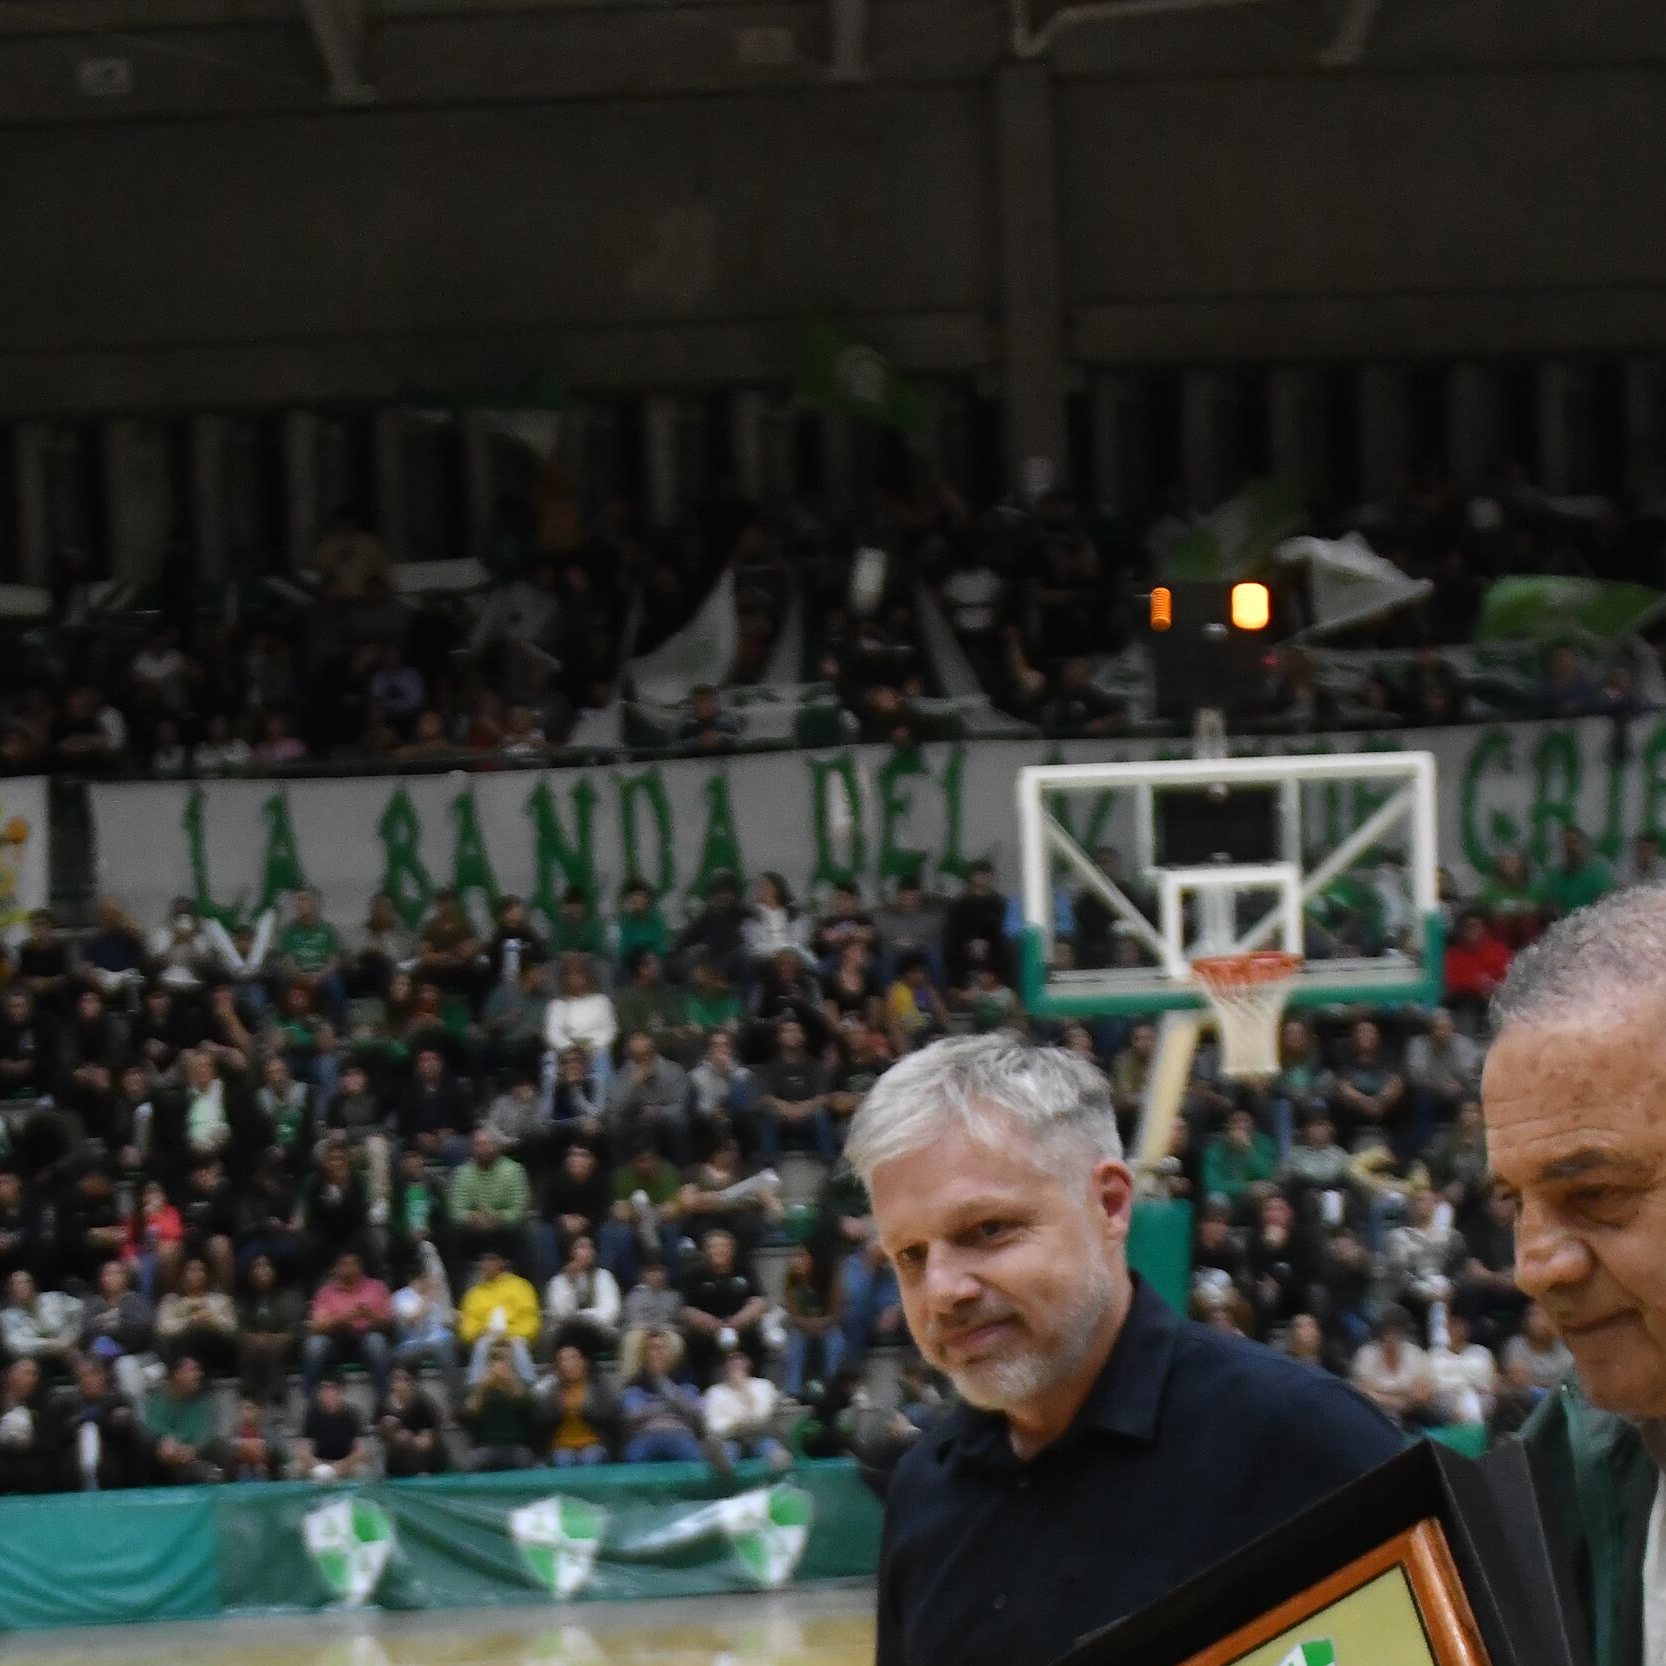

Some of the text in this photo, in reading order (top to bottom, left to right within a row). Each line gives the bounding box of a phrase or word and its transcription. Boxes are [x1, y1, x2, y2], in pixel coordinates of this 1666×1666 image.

[184, 782, 307, 932] LA
[377, 762, 745, 922] BANDA
[806, 738, 993, 900] DEL
